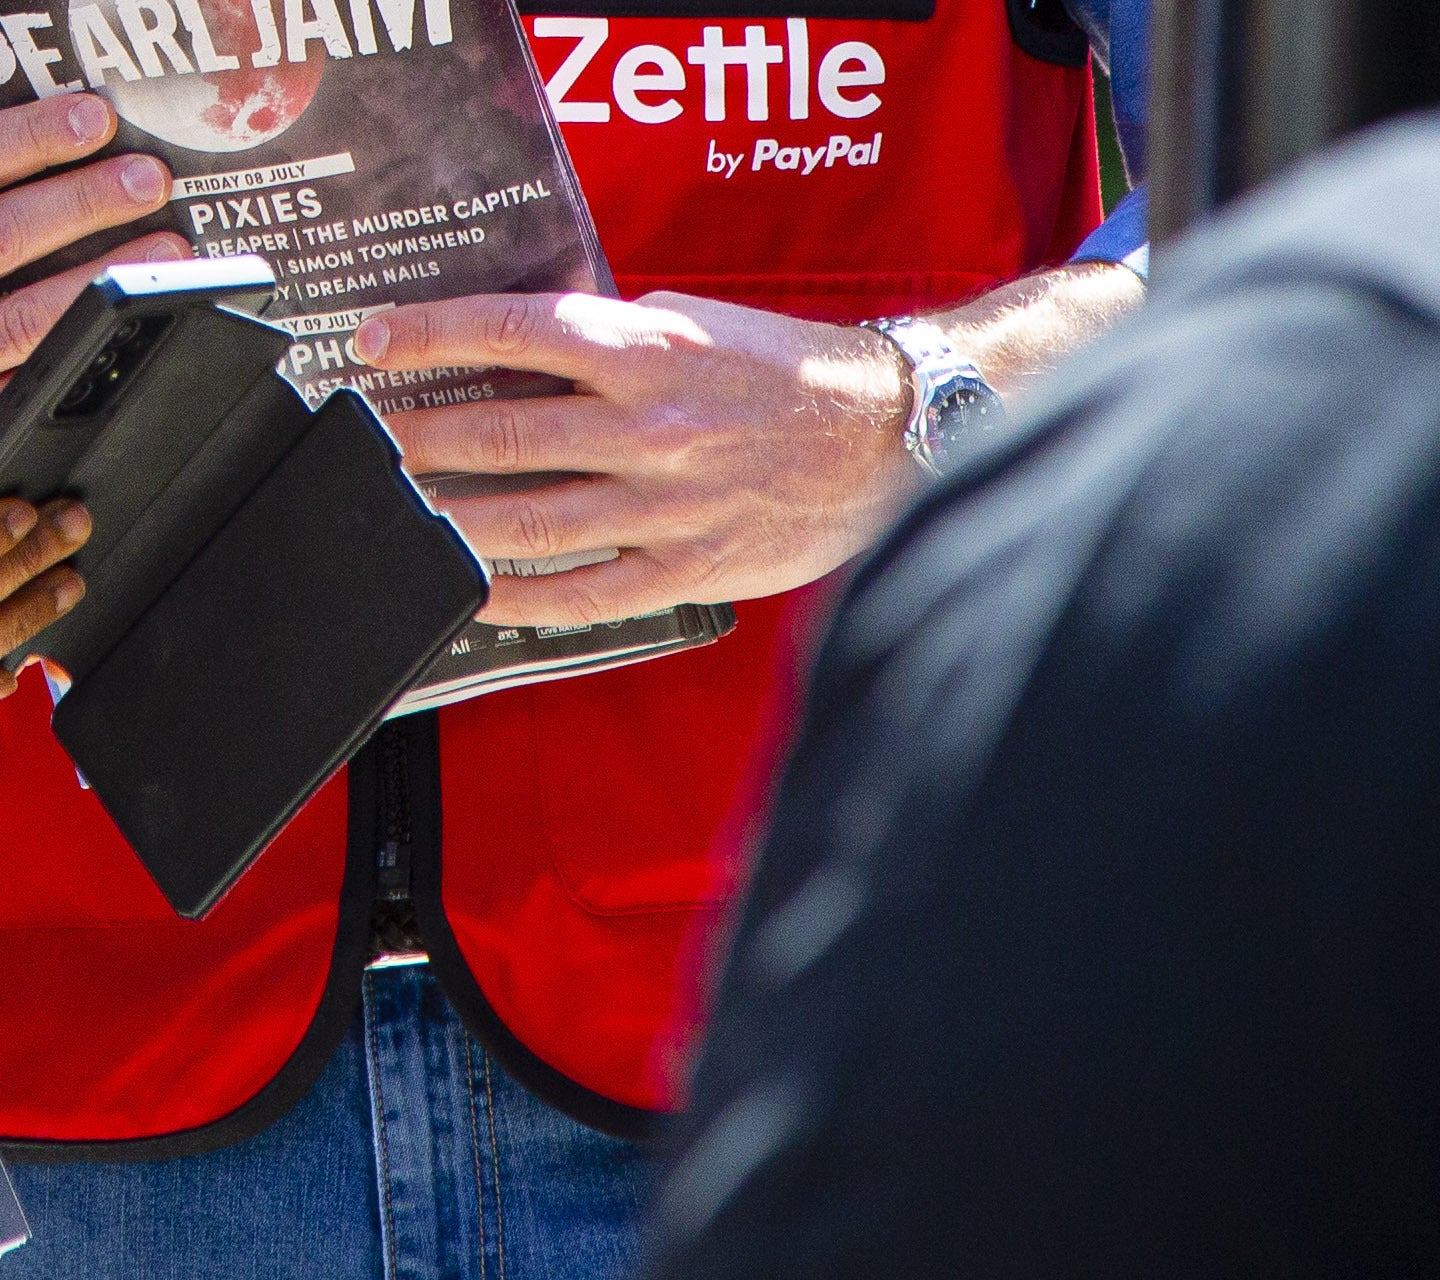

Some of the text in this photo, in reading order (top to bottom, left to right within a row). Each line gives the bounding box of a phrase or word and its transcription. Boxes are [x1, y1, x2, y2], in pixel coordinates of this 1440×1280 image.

[533, 16, 886, 124] Zettle
[706, 131, 883, 179] by PayPal
[183, 164, 306, 195] FRIDAY 08 JULY
[188, 187, 323, 235] PIXIES
[205, 233, 290, 258] REAPER
[302, 221, 349, 247] THE
[352, 204, 450, 237] MURDER
[452, 179, 552, 220] CAPITAL
[287, 227, 486, 275] SIMON TOWNSHEND
[305, 273, 378, 299] DREAM
[382, 261, 441, 285] NAILS
[303, 318, 322, 331] 09
[327, 311, 364, 329] JULY
[420, 383, 496, 409] THINGS
